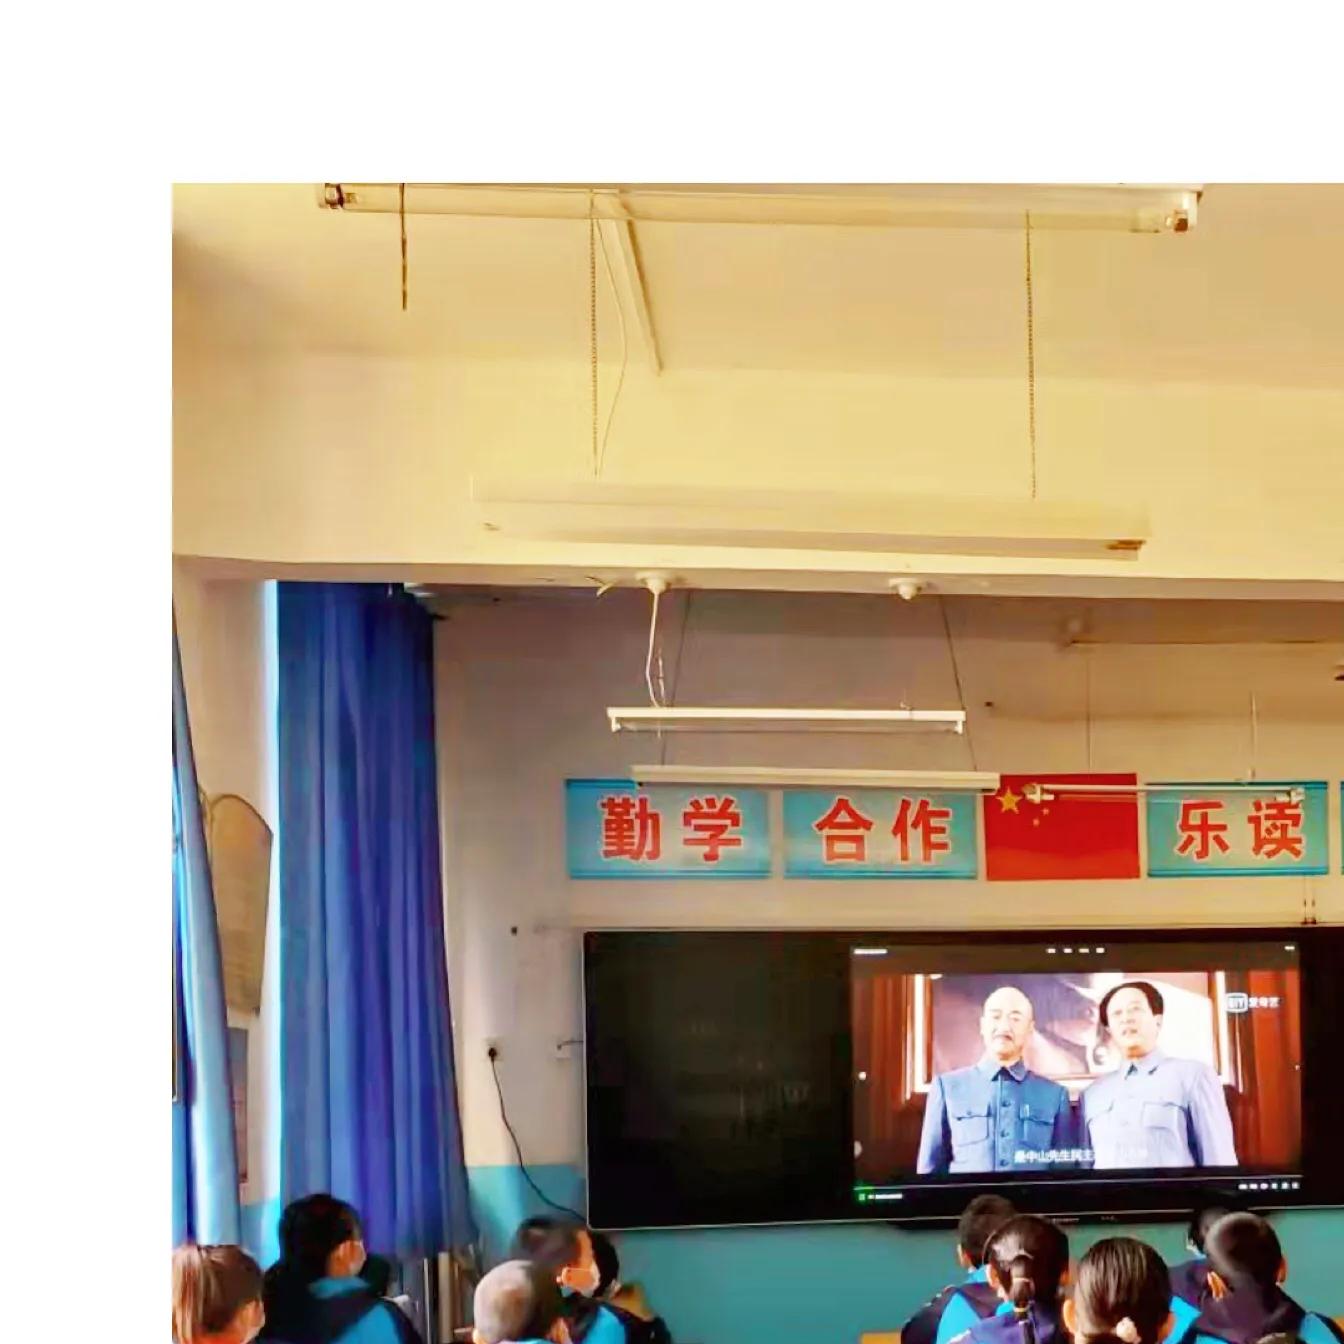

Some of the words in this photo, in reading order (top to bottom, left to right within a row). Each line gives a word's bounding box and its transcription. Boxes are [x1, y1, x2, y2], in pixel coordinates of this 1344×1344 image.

[602, 796, 743, 862] 勤学
[815, 797, 951, 862] 合作
[1177, 797, 1303, 860] 乐读
